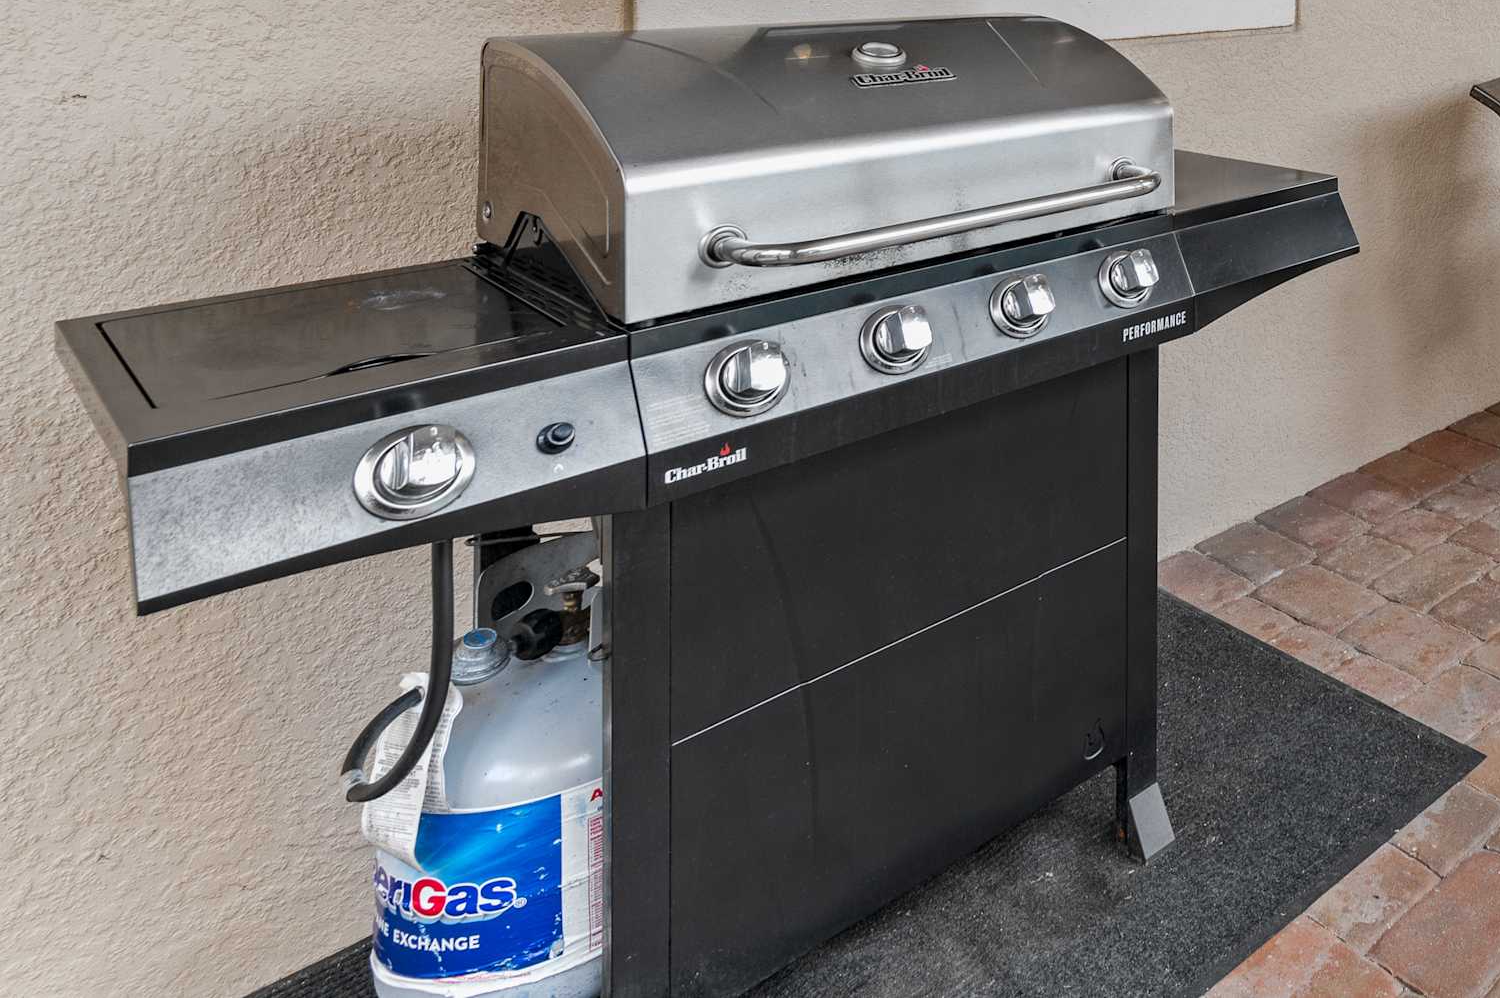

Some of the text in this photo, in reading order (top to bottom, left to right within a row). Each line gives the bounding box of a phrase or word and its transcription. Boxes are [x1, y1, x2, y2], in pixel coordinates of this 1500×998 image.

[1123, 311, 1186, 342] PERFORMANCE
[664, 447, 747, 484] Char-Broil
[393, 930, 480, 952] EXCHANGE
